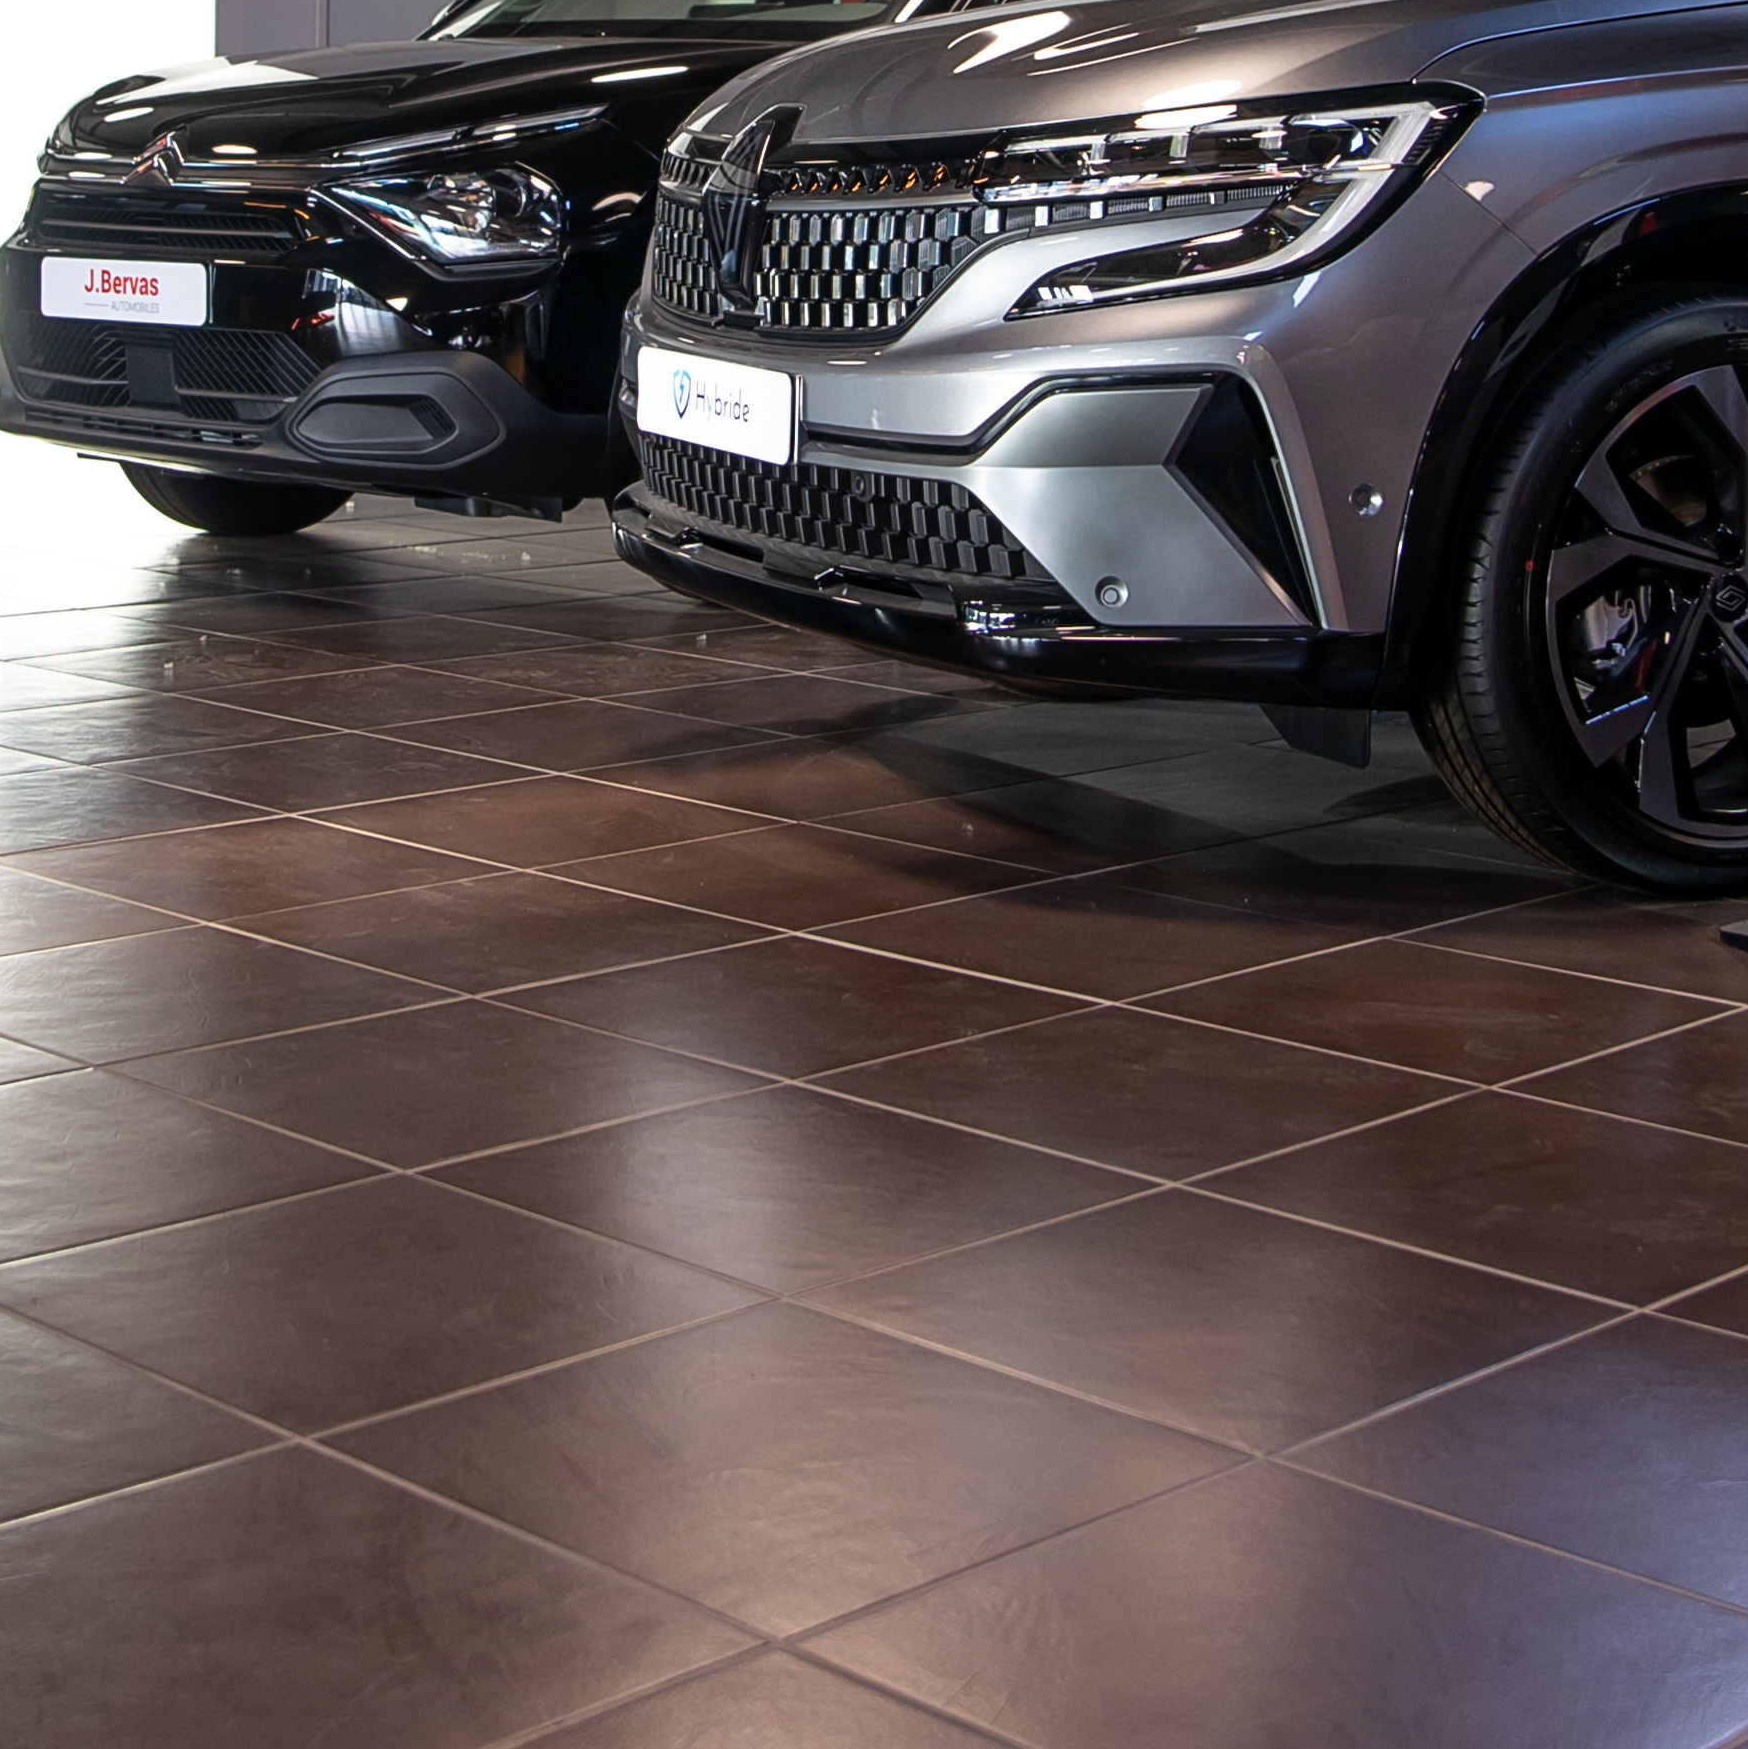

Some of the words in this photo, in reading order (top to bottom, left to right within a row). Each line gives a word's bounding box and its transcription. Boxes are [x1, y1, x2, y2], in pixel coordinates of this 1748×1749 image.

[84, 268, 159, 296] J.Bervas
[110, 300, 160, 314] AUTOMOBILES
[696, 381, 750, 422] Hybride
